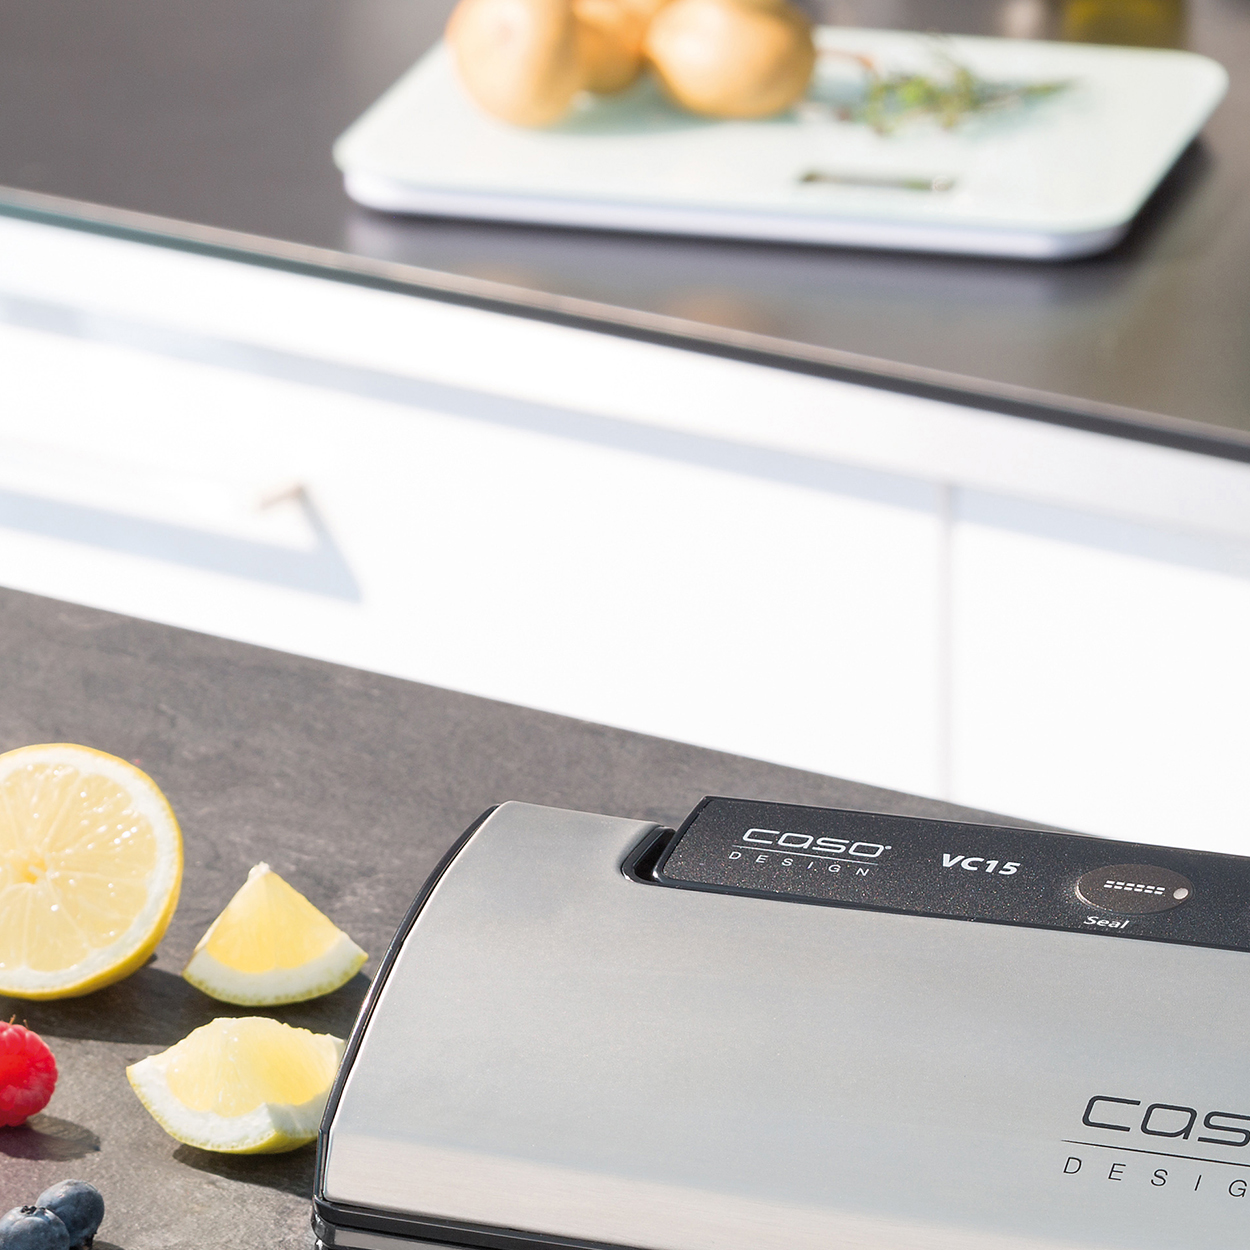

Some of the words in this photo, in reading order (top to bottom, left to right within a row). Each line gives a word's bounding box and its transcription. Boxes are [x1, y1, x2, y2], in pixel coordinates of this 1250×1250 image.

[728, 851, 870, 877] DESIGN
[942, 853, 1021, 876] VC15
[1083, 915, 1130, 930] Seal
